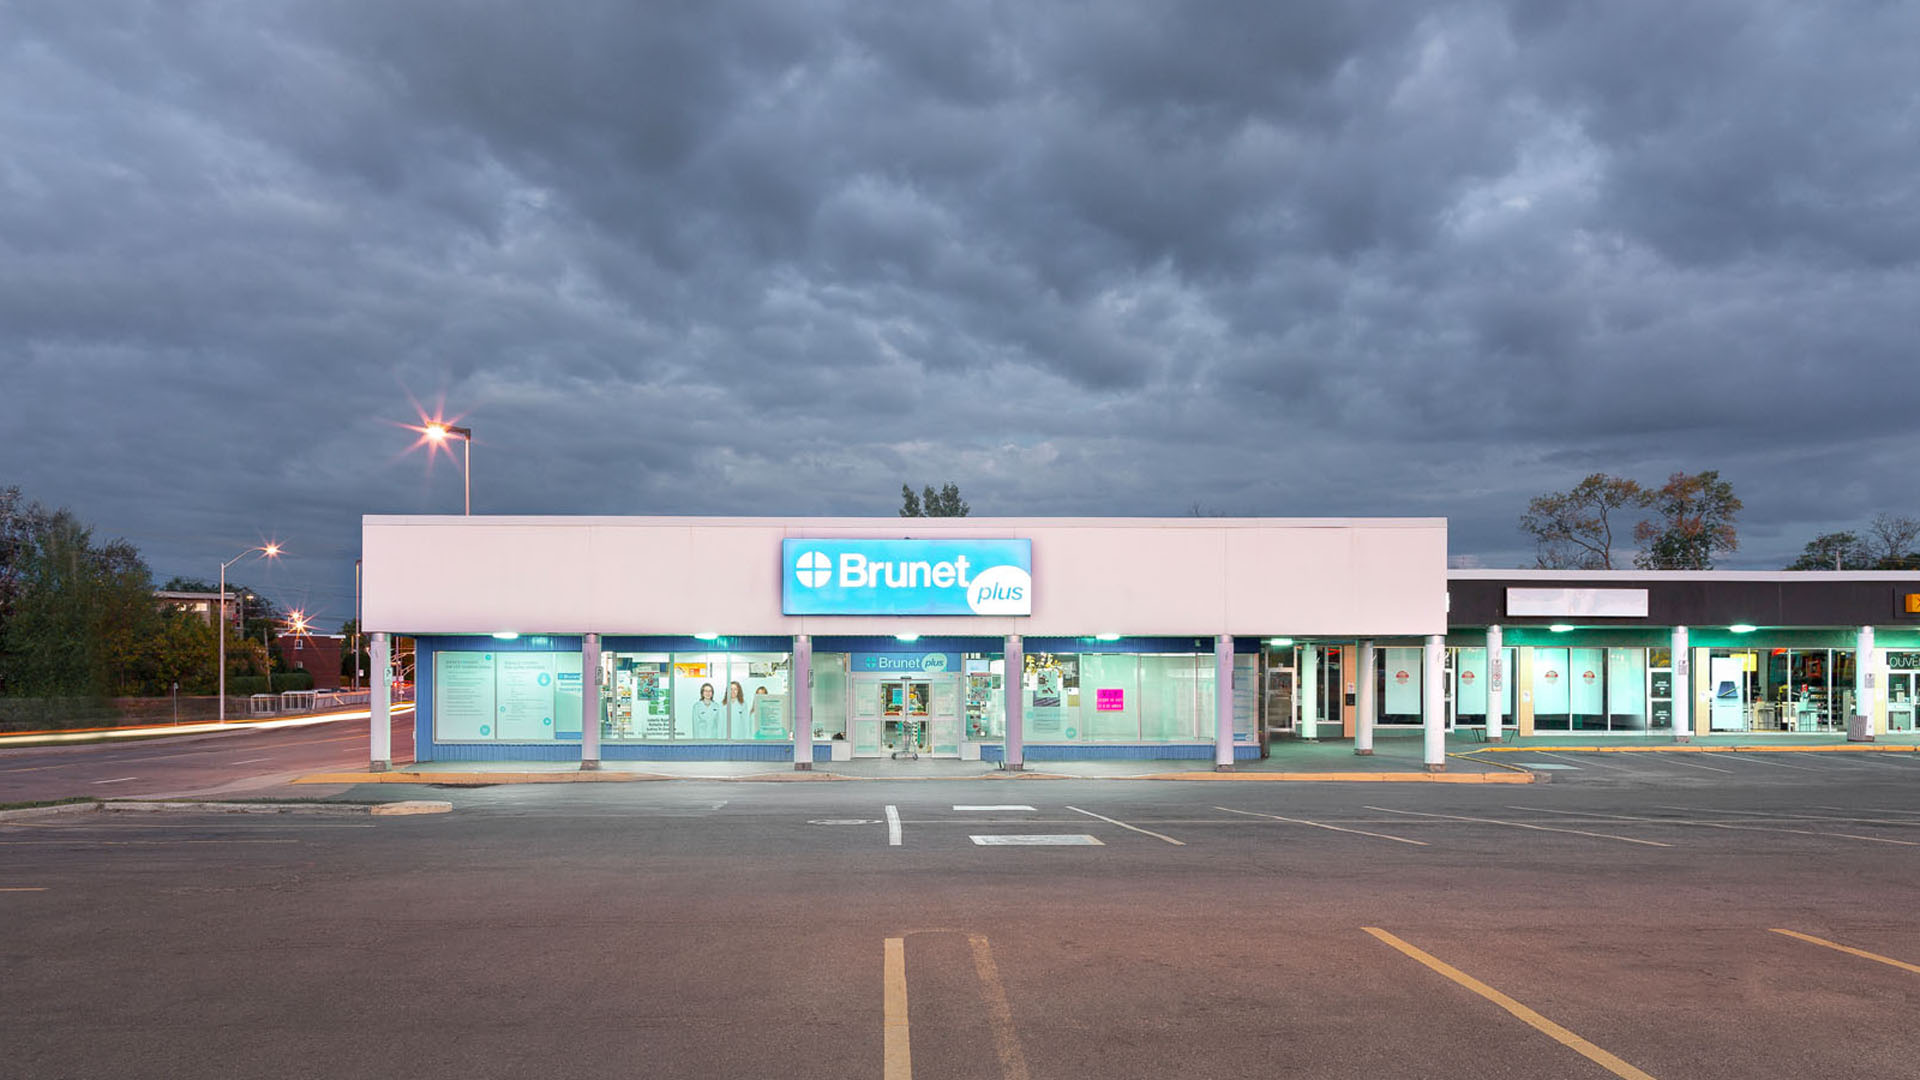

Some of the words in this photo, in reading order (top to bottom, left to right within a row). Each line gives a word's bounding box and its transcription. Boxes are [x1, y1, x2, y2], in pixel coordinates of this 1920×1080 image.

[839, 552, 971, 588] Brunet
[977, 582, 1024, 604] plus
[879, 656, 920, 668] Brunet
[925, 657, 945, 668] plus
[1889, 656, 1920, 668] OUVE
